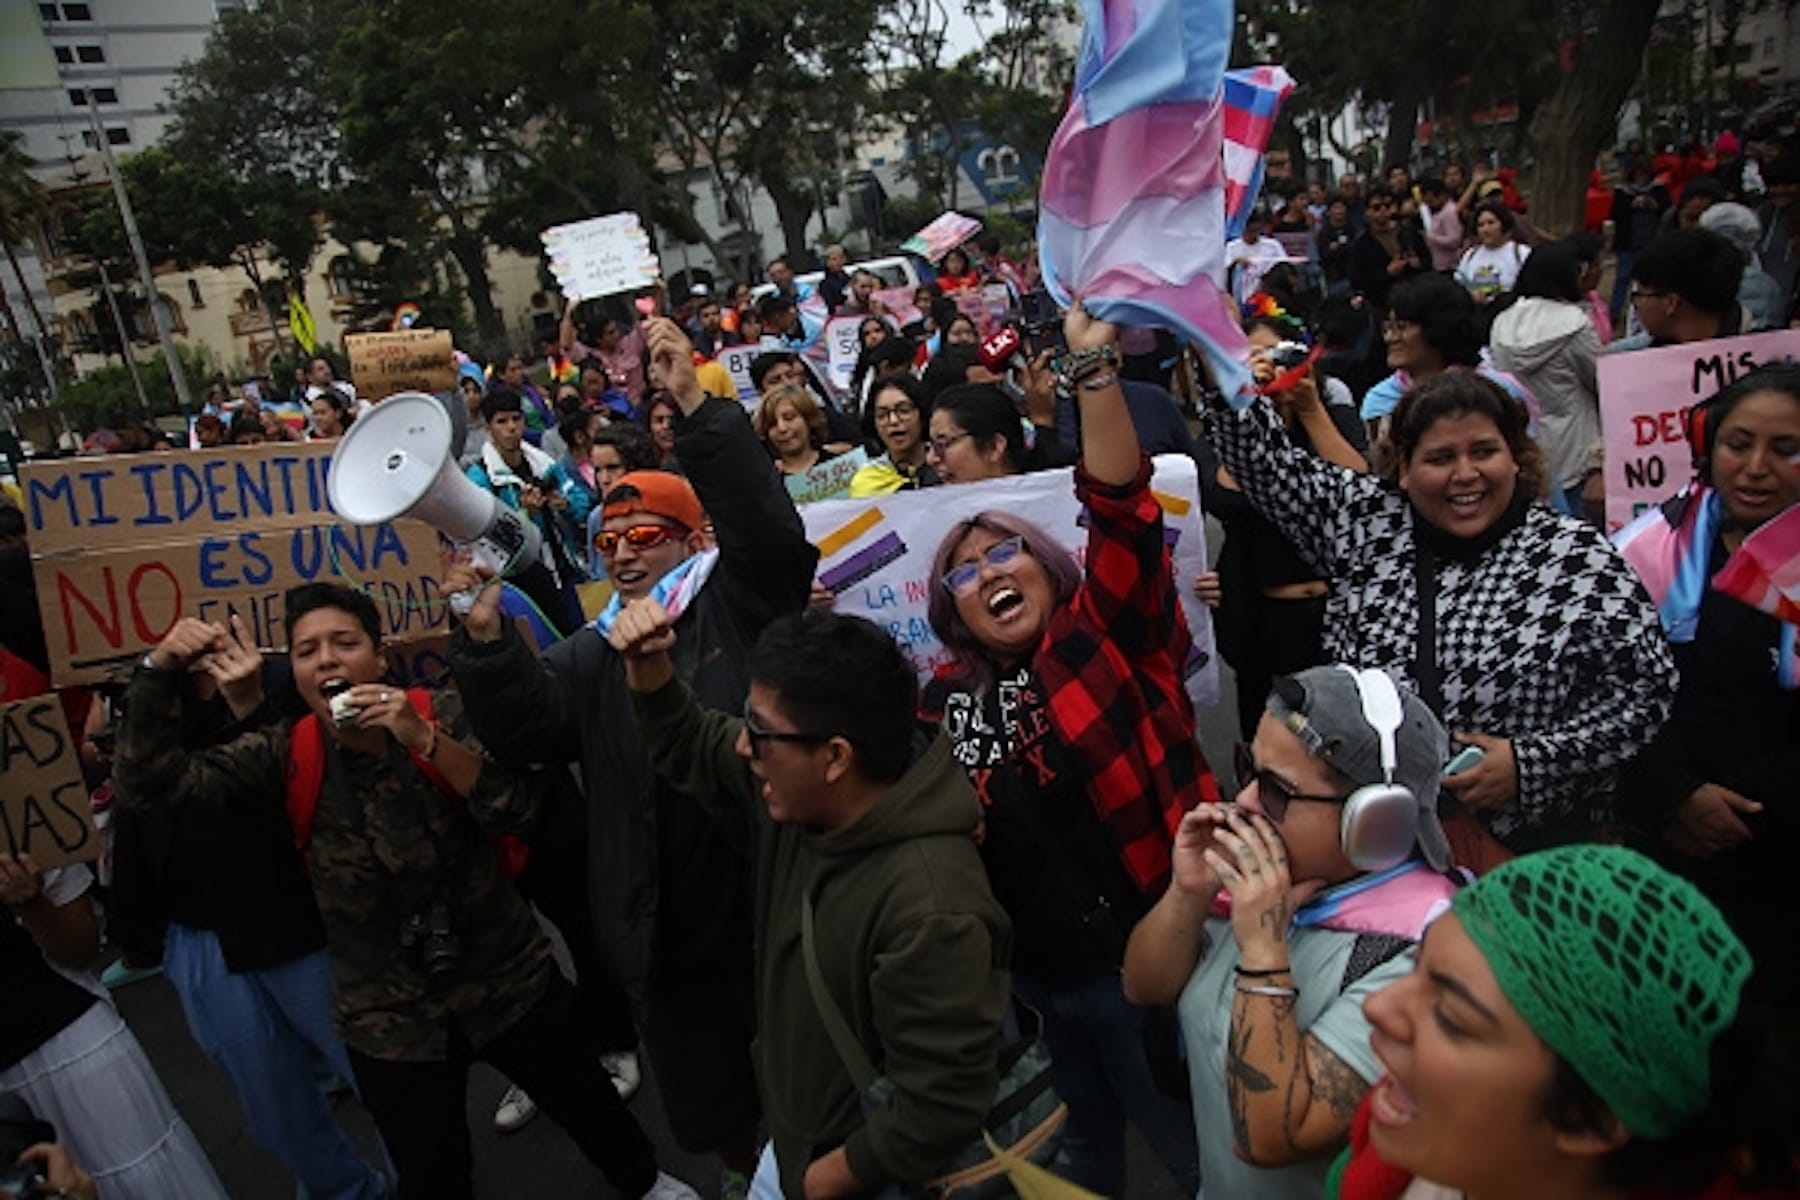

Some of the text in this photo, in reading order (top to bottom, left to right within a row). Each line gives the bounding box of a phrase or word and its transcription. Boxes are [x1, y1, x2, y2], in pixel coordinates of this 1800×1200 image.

[28, 471, 117, 531] MI
[1624, 455, 1665, 488] NO
[200, 523, 409, 589] ES UNA
[57, 560, 183, 655] NO
[865, 583, 897, 610] LA
